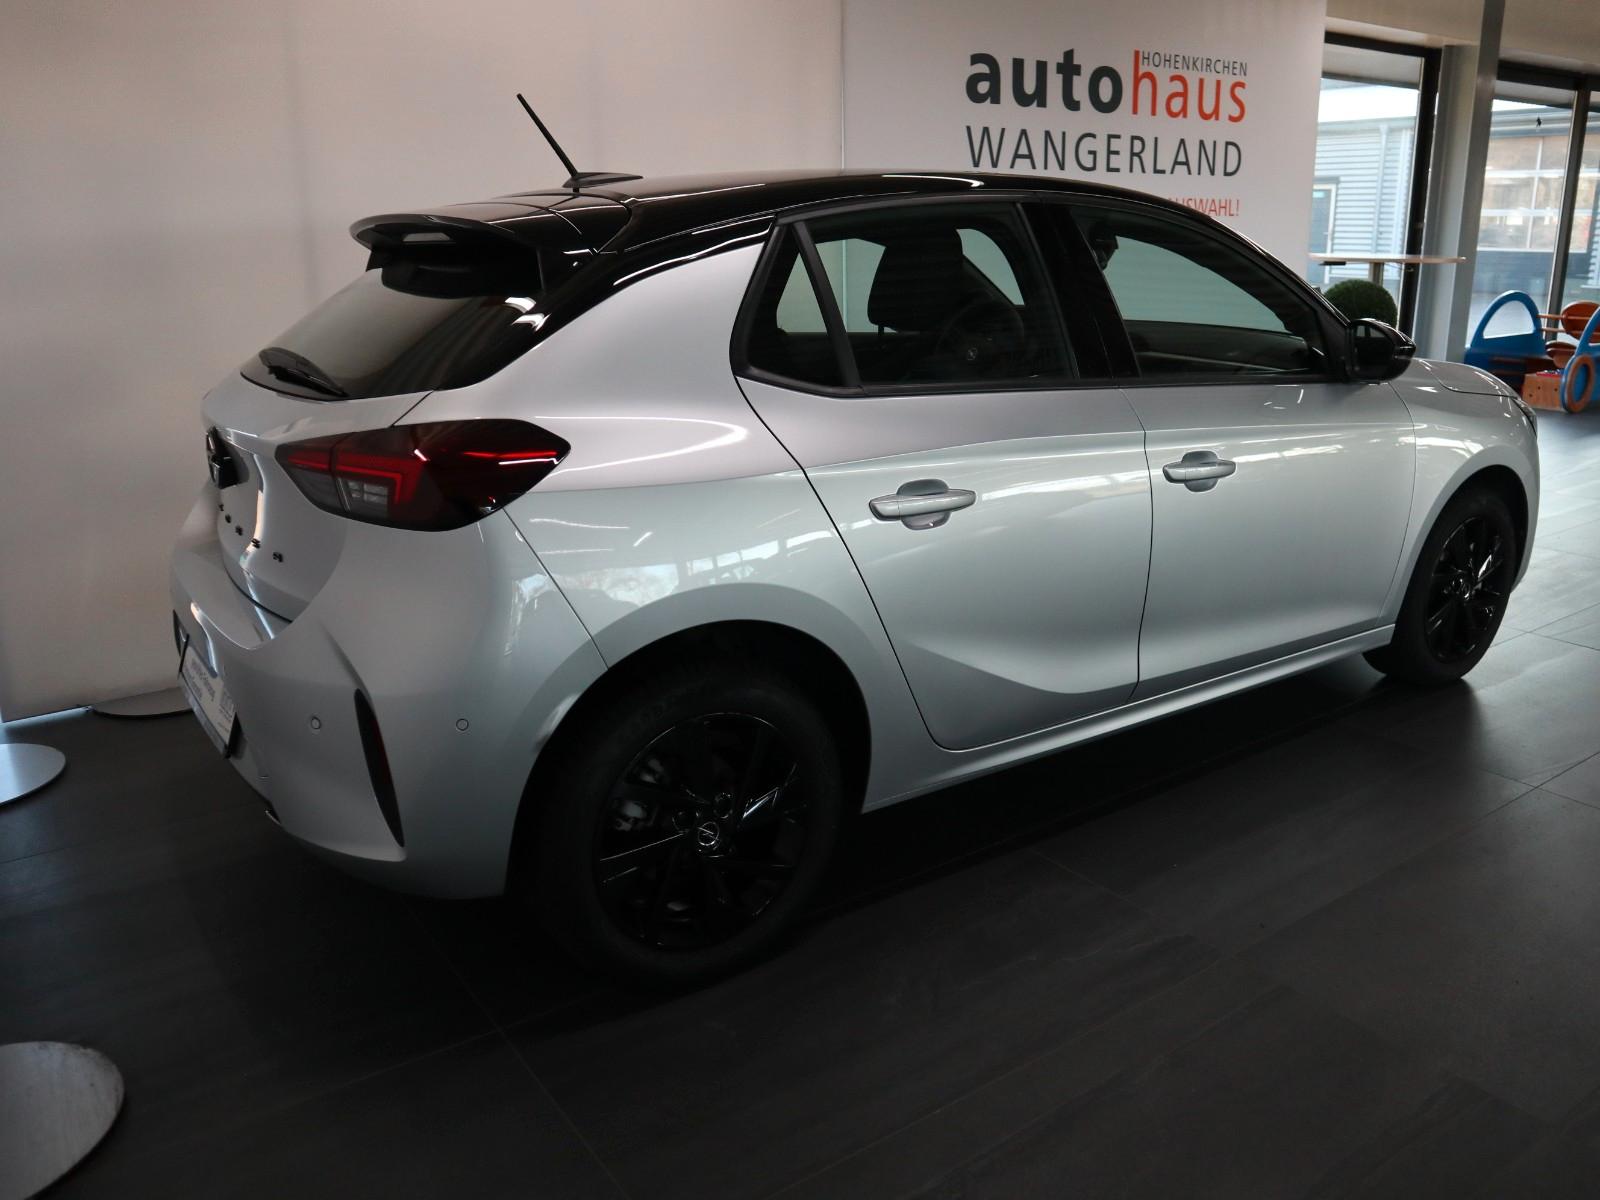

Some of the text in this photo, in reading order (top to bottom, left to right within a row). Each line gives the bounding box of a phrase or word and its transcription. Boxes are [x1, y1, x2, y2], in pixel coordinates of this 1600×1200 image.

[1141, 50, 1247, 77] HOHENKIRCHEN
[965, 48, 1246, 123] autohaus
[966, 125, 1242, 177] WANGERLAND
[1168, 197, 1240, 217] SWAHL!
